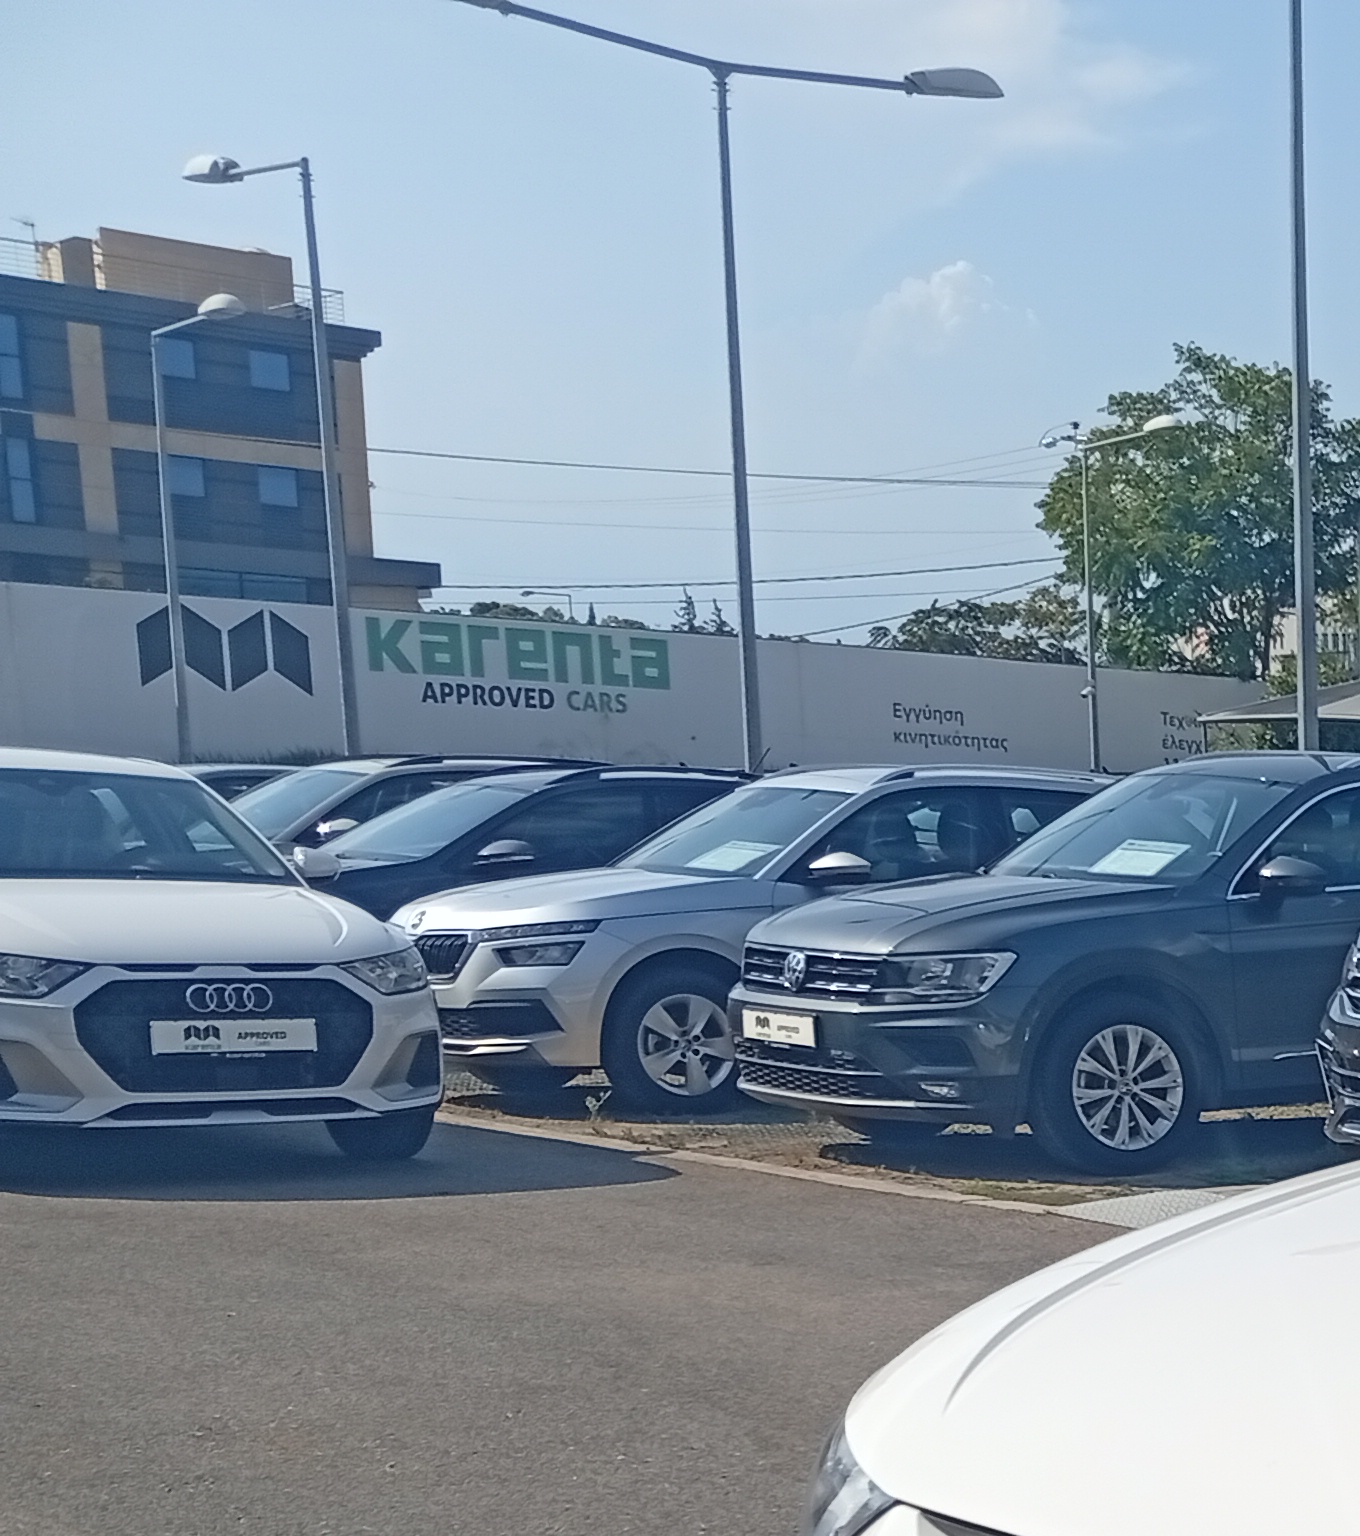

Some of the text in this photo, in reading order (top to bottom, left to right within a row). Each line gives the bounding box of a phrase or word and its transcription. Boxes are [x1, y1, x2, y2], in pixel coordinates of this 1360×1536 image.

[421, 681, 628, 713] APPROVED CARS
[892, 702, 964, 726] Εγγύηση
[893, 730, 1008, 753] κινητικότητας
[1162, 734, 1203, 754] έλεγχ
[237, 1031, 287, 1040] APPROVED
